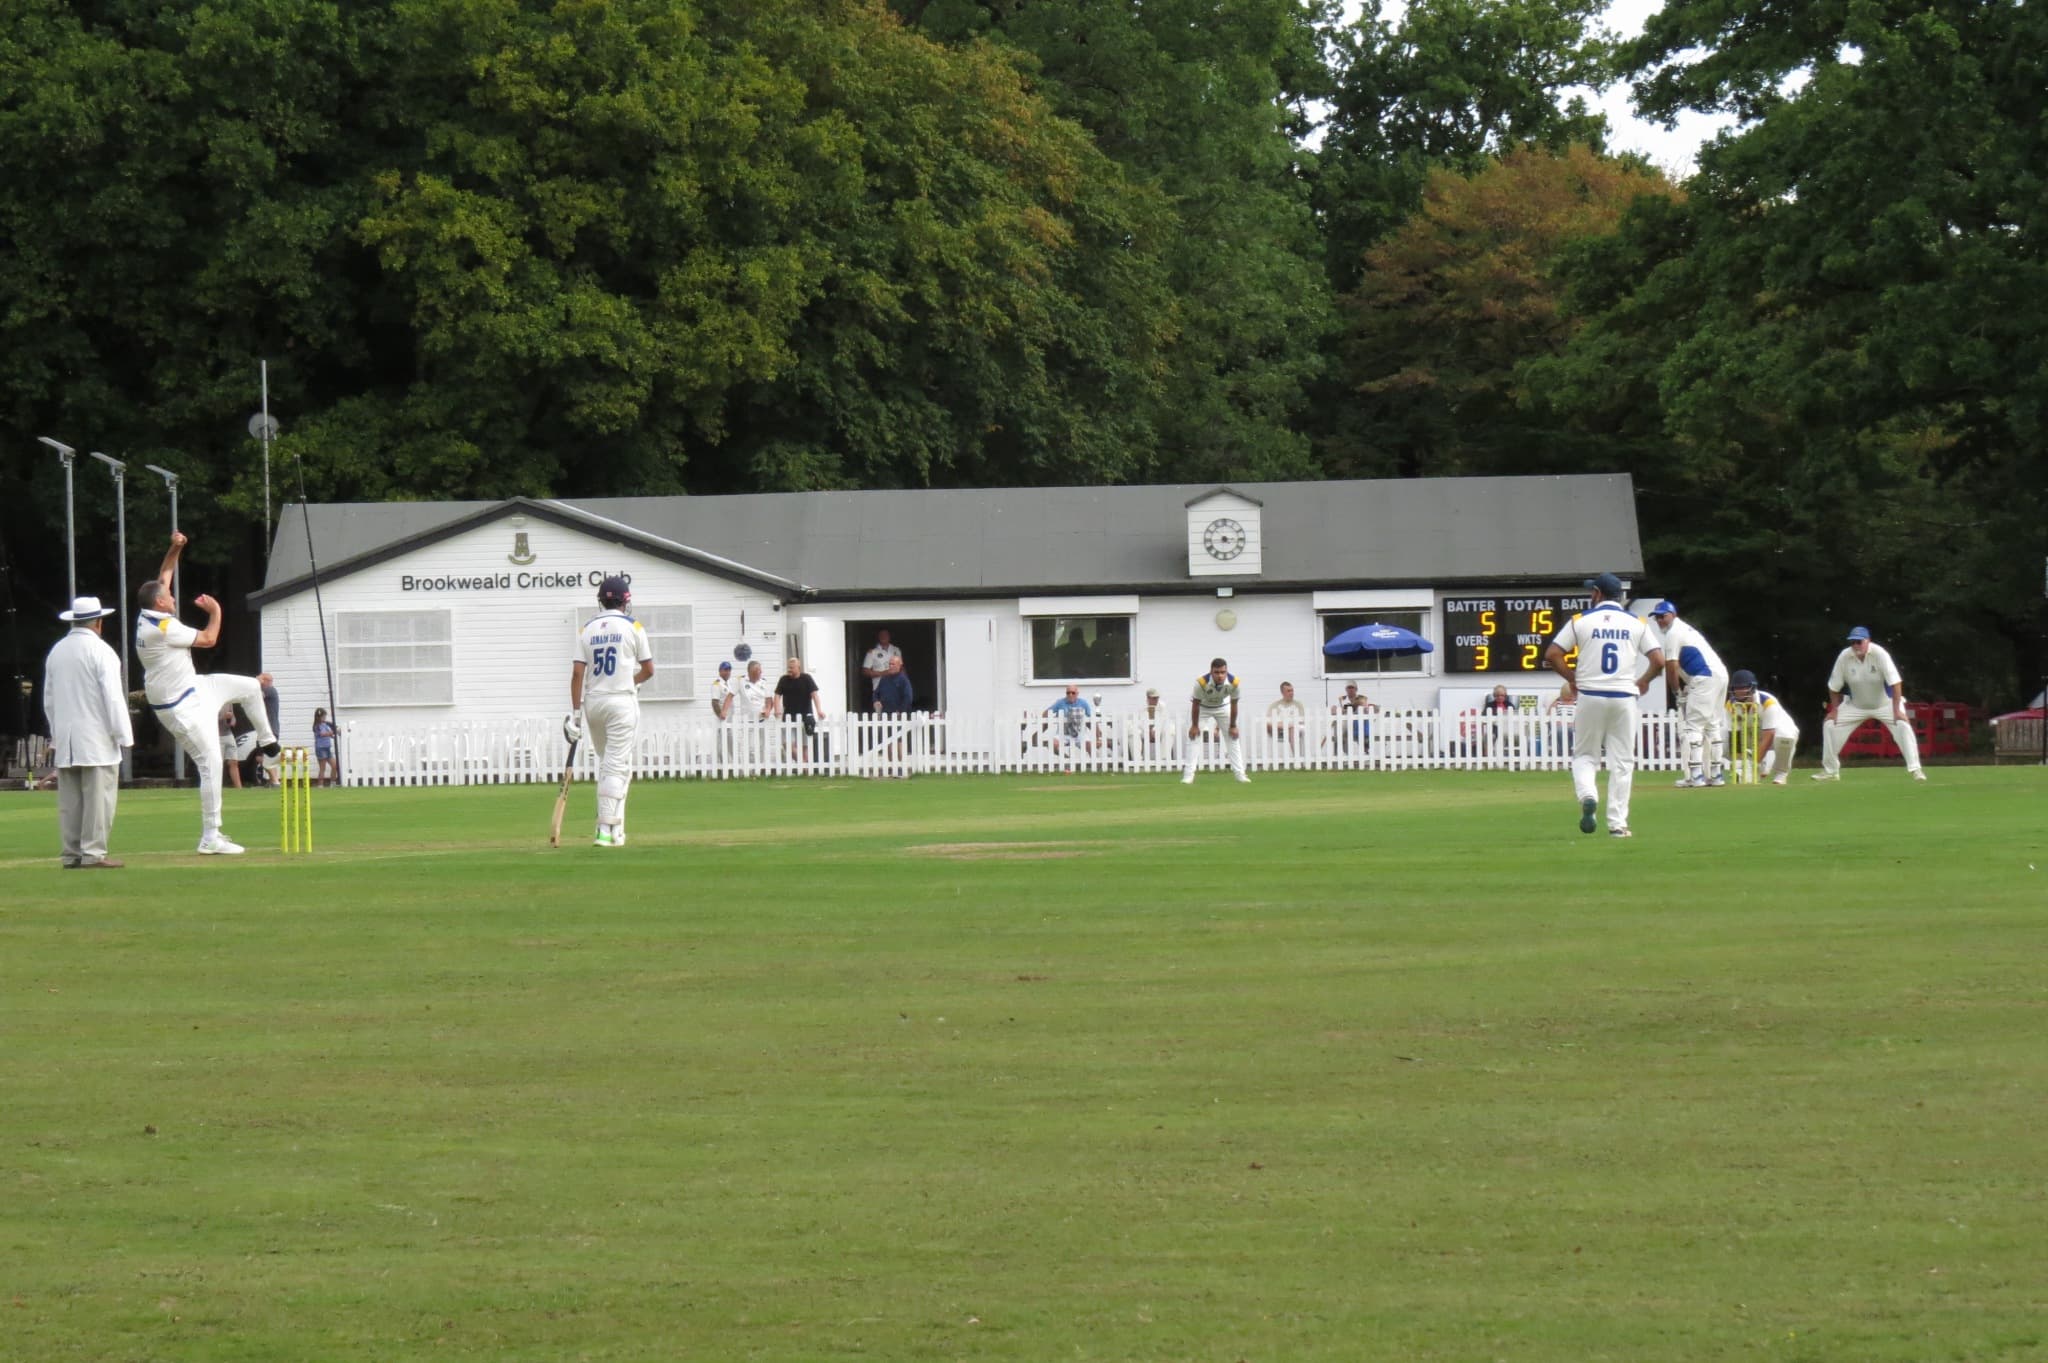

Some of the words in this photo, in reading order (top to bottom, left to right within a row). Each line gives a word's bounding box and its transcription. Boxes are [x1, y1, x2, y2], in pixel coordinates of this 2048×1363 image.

[402, 573, 510, 591] Brookweald
[517, 571, 582, 589] Cricket
[588, 570, 632, 587] Clb
[1447, 600, 1496, 612] BATTER
[1504, 599, 1553, 611] TOTAL
[1561, 598, 1592, 610] BATT
[1481, 611, 1496, 635] 5
[1531, 610, 1553, 635] 15
[1456, 635, 1489, 647] OVERS
[1517, 634, 1542, 646] WKTS
[1592, 628, 1630, 640] AMIR
[593, 646, 617, 676] 56
[1475, 646, 1489, 670] 3
[1522, 645, 1538, 669] 2
[1601, 642, 1618, 675] 6
